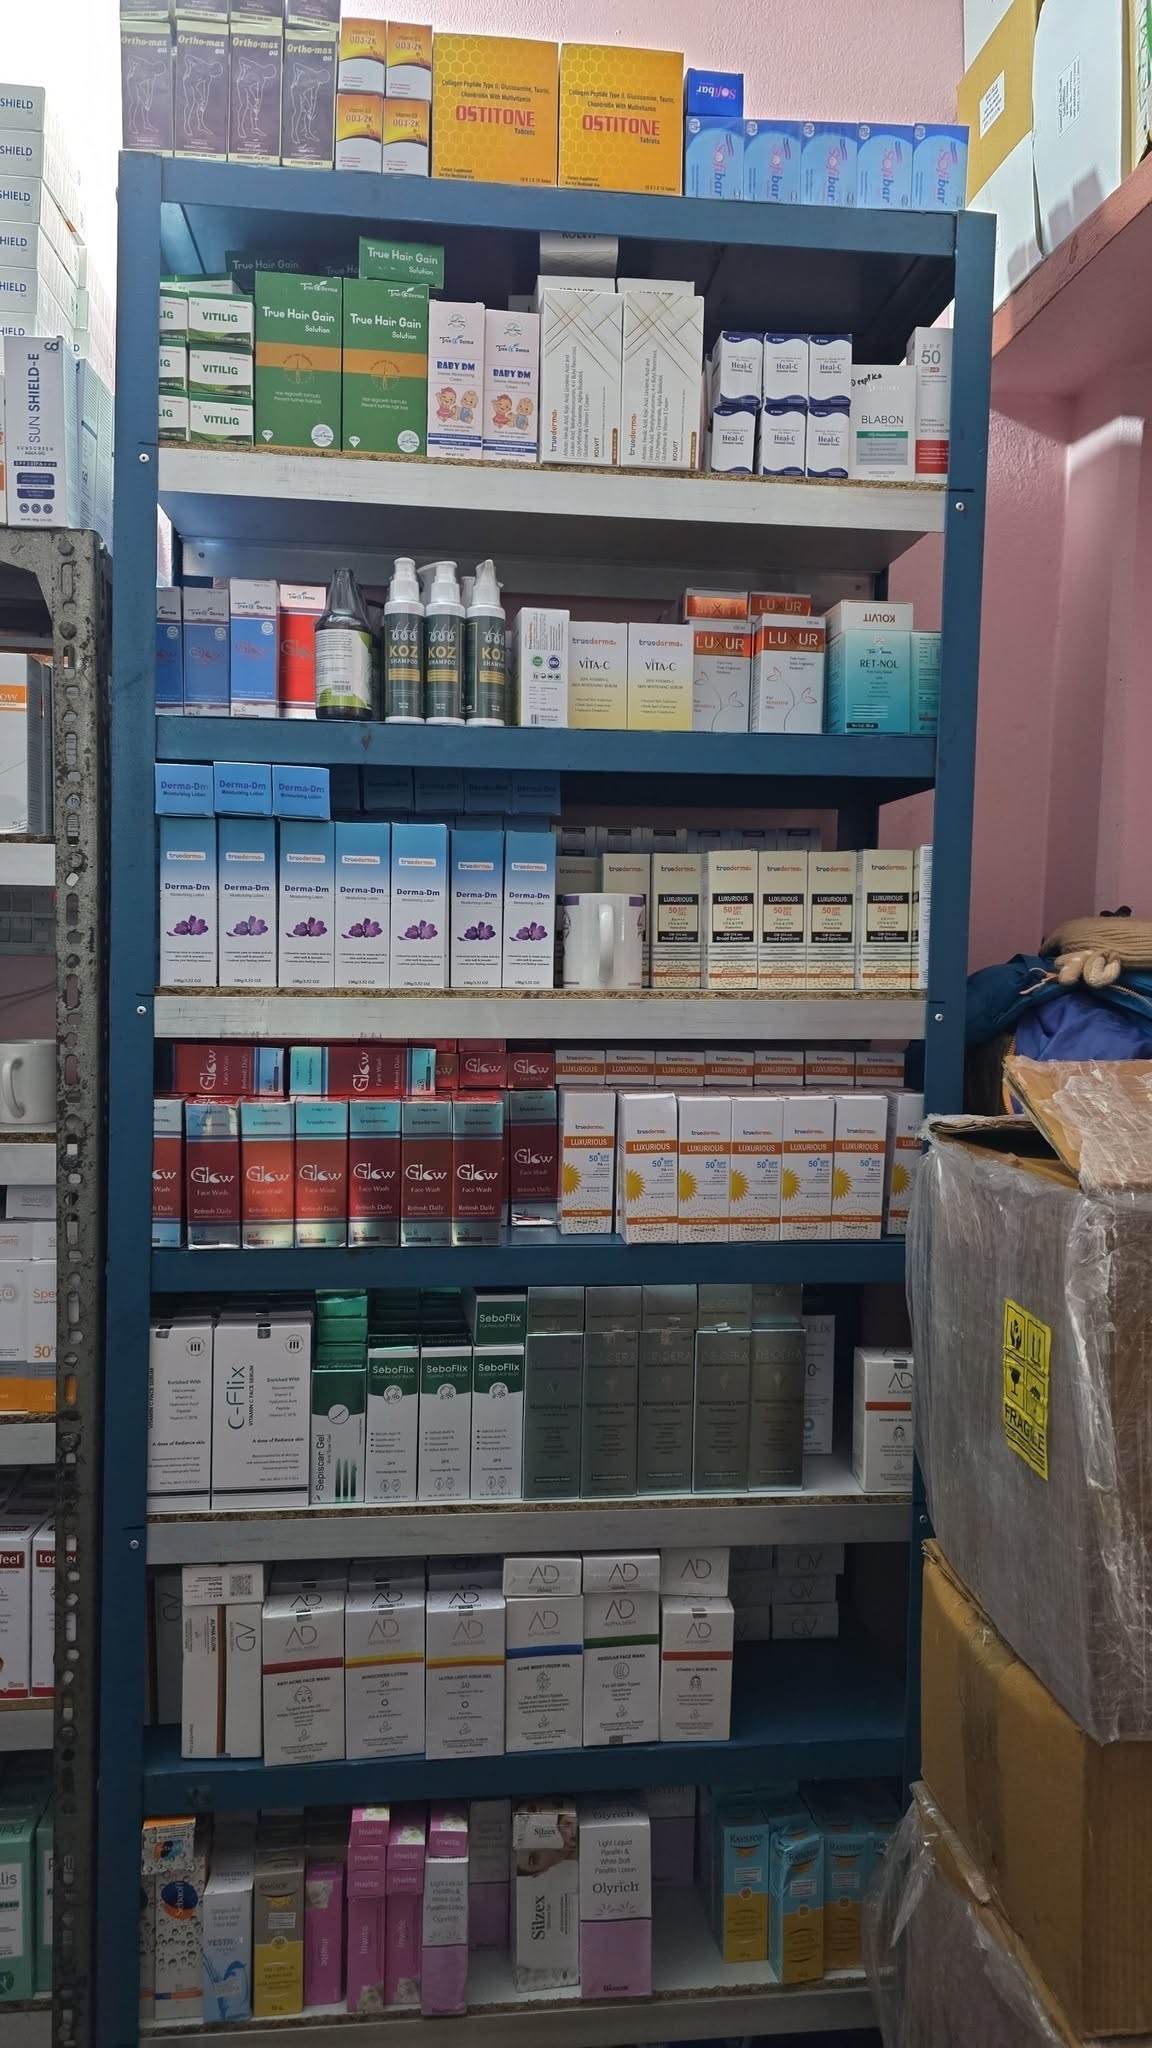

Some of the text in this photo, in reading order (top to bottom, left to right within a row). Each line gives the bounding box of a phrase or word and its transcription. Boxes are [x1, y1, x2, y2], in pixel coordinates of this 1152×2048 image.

[121, 35, 167, 47] Ortho-max
[178, 35, 225, 47] Ortho-max
[232, 37, 278, 49] Ortho-max
[287, 44, 332, 54] Ortho-max
[456, 105, 535, 128] OSTITONE
[582, 114, 660, 136] OSTITONE
[514, 128, 535, 136] Tablets
[640, 136, 660, 145] Tablets
[367, 246, 438, 265] True Hair Gain
[408, 266, 434, 276] Solution
[202, 311, 238, 323] VITILIG
[262, 306, 335, 323] True Hair Gain
[350, 313, 422, 329] True Hair Gain
[305, 325, 330, 334] Solution
[391, 331, 417, 340] Solution
[921, 350, 941, 364] 50
[202, 364, 238, 375] VITILIG
[436, 361, 475, 371] BABY DM
[731, 362, 753, 370] Heal-C
[776, 362, 798, 371] Heal-C
[819, 363, 842, 372] Heal-C
[493, 369, 531, 379] BABY DM
[28, 353, 41, 443] SUN SHIELD-E
[203, 415, 240, 425] VITILIG
[861, 415, 904, 424] BLABON
[722, 434, 745, 442] Heal-C
[774, 434, 795, 442] Heal-C
[818, 436, 840, 444] Heal-C
[760, 599, 802, 612] LUXUR
[863, 613, 895, 623] KOLVIT
[695, 636, 745, 650] LUXUR
[768, 631, 817, 646] LUXUR
[389, 645, 418, 658] KOZ
[428, 646, 456, 658] KOZ
[161, 781, 208, 791] Derma-Dm
[219, 780, 266, 790] Derma-Dm
[279, 783, 324, 793] Derma-Dm
[165, 883, 210, 891] Derma-Dm
[224, 883, 269, 891] Derma-Dm
[284, 884, 329, 893] Derma-Dm
[340, 886, 384, 895] Derma-Dm
[396, 888, 440, 896] Derma-Dm
[456, 891, 498, 899] Derma-Dm
[509, 891, 550, 899] Derma-Dm
[200, 1049, 217, 1090] Glow
[465, 1058, 501, 1073] Glow
[514, 1059, 550, 1074] Glow
[562, 1065, 598, 1073] LUXURIOUS
[612, 1065, 648, 1073] LUXURIOUS
[662, 1066, 698, 1074] LUXURIOUS
[712, 1066, 747, 1074] LUXURIOUS
[353, 1052, 369, 1091] Glow
[571, 1138, 607, 1146] LUXURIOUS
[633, 1143, 670, 1151] LUXURIOUS
[790, 1143, 827, 1151] LUXURIOUS
[687, 1144, 724, 1152] LUXURIOUS
[739, 1144, 775, 1152] LUXURIOUS
[514, 1149, 553, 1164] Glow
[191, 1167, 235, 1184] Glow
[246, 1166, 290, 1183] Glow
[300, 1164, 342, 1181] Glow
[353, 1163, 395, 1180] Glow
[405, 1164, 447, 1181] Glow
[456, 1164, 498, 1181] Glow
[480, 1314, 521, 1322] SeboFlix
[372, 1366, 414, 1374] SeboFlix
[426, 1364, 468, 1373] SeboFlix
[478, 1364, 519, 1372] SeboFlix
[1004, 1403, 1045, 1450] FRAGILE
[316, 1434, 325, 1490] Sepiscar Gel
[592, 1881, 639, 1895] Olyrich
[531, 1896, 545, 1940] Silzex
